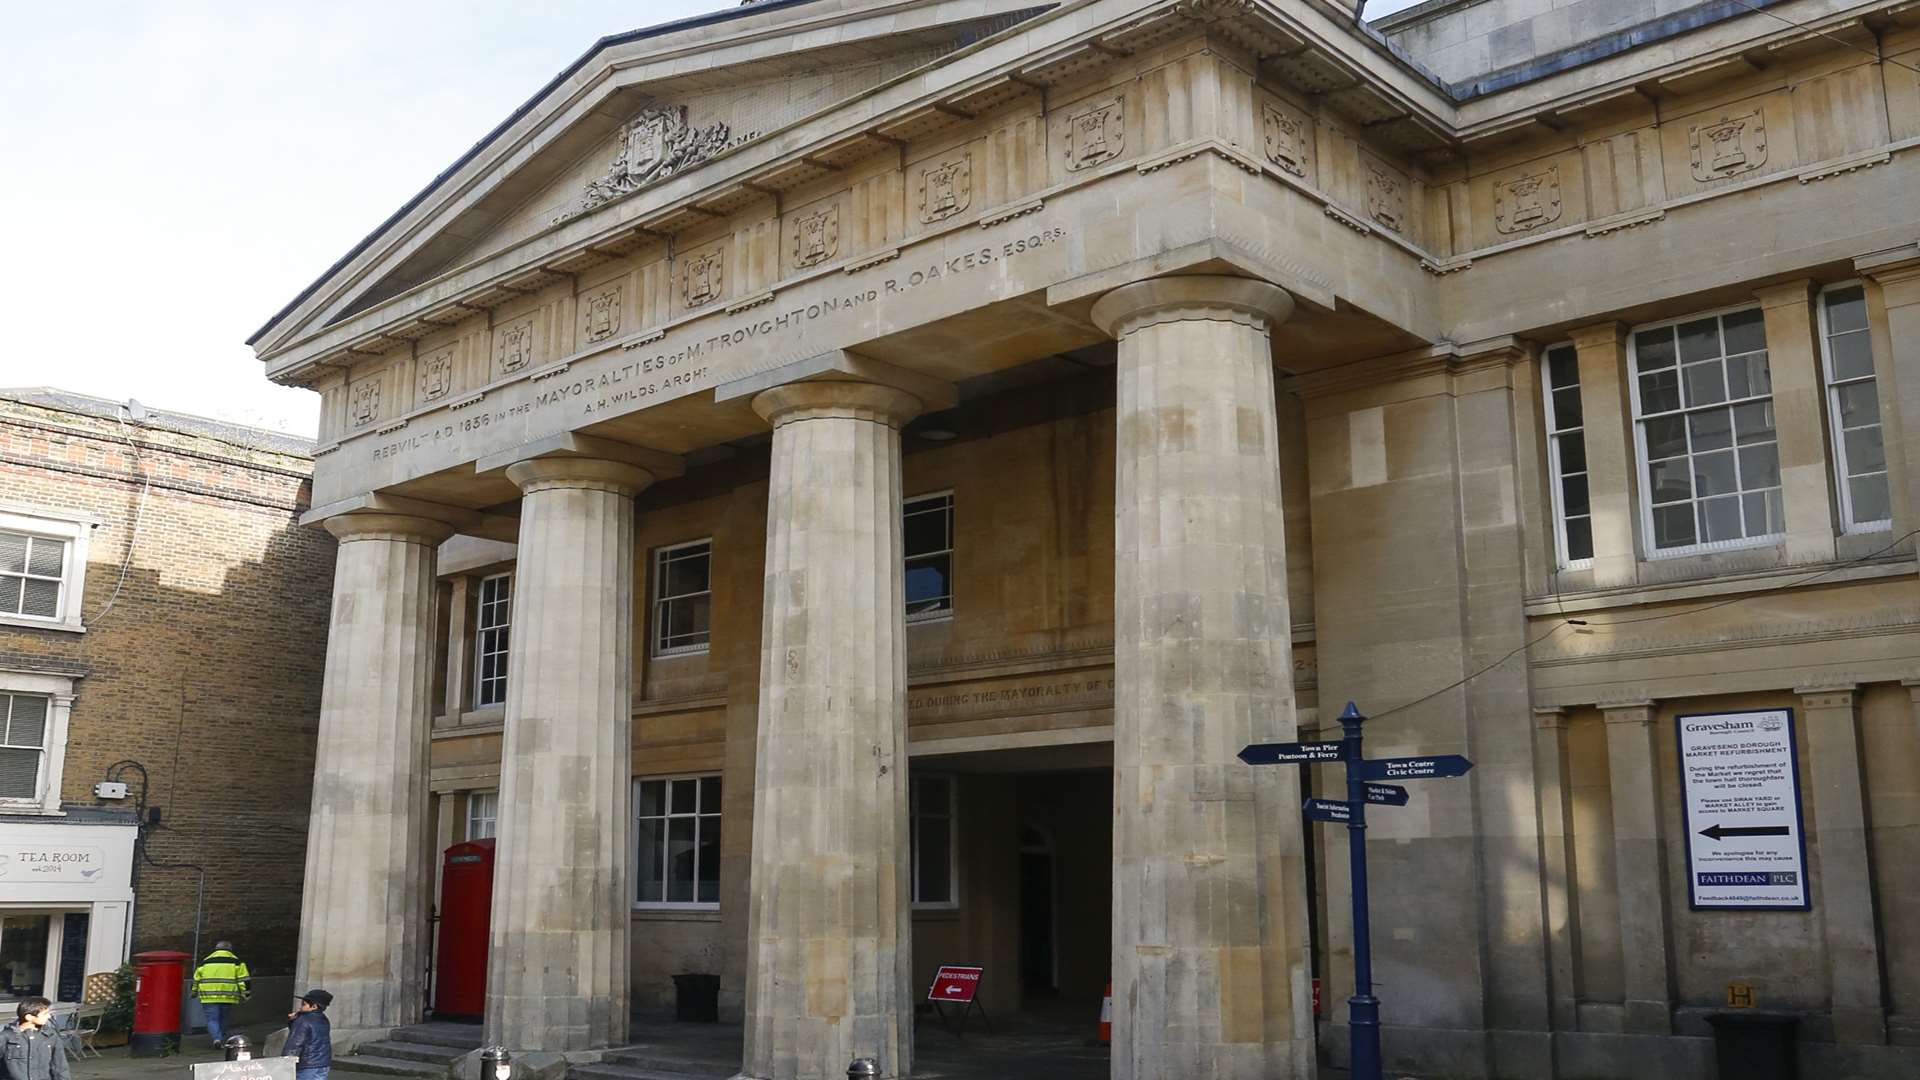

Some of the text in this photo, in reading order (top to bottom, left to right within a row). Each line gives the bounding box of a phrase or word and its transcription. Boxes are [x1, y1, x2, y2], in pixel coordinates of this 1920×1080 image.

[509, 403, 530, 416] THE
[536, 355, 665, 408] MAYORALTIES
[668, 352, 684, 365] OF
[842, 290, 877, 309] AND
[1686, 721, 1754, 732] Gravesham
[1690, 741, 1781, 751] GRAVESEND BOROUGH
[1720, 747, 1787, 756] REFURBISHMENT
[18, 852, 90, 862] TEA ROOM
[1701, 874, 1794, 883] FAITHDEAN PLC
